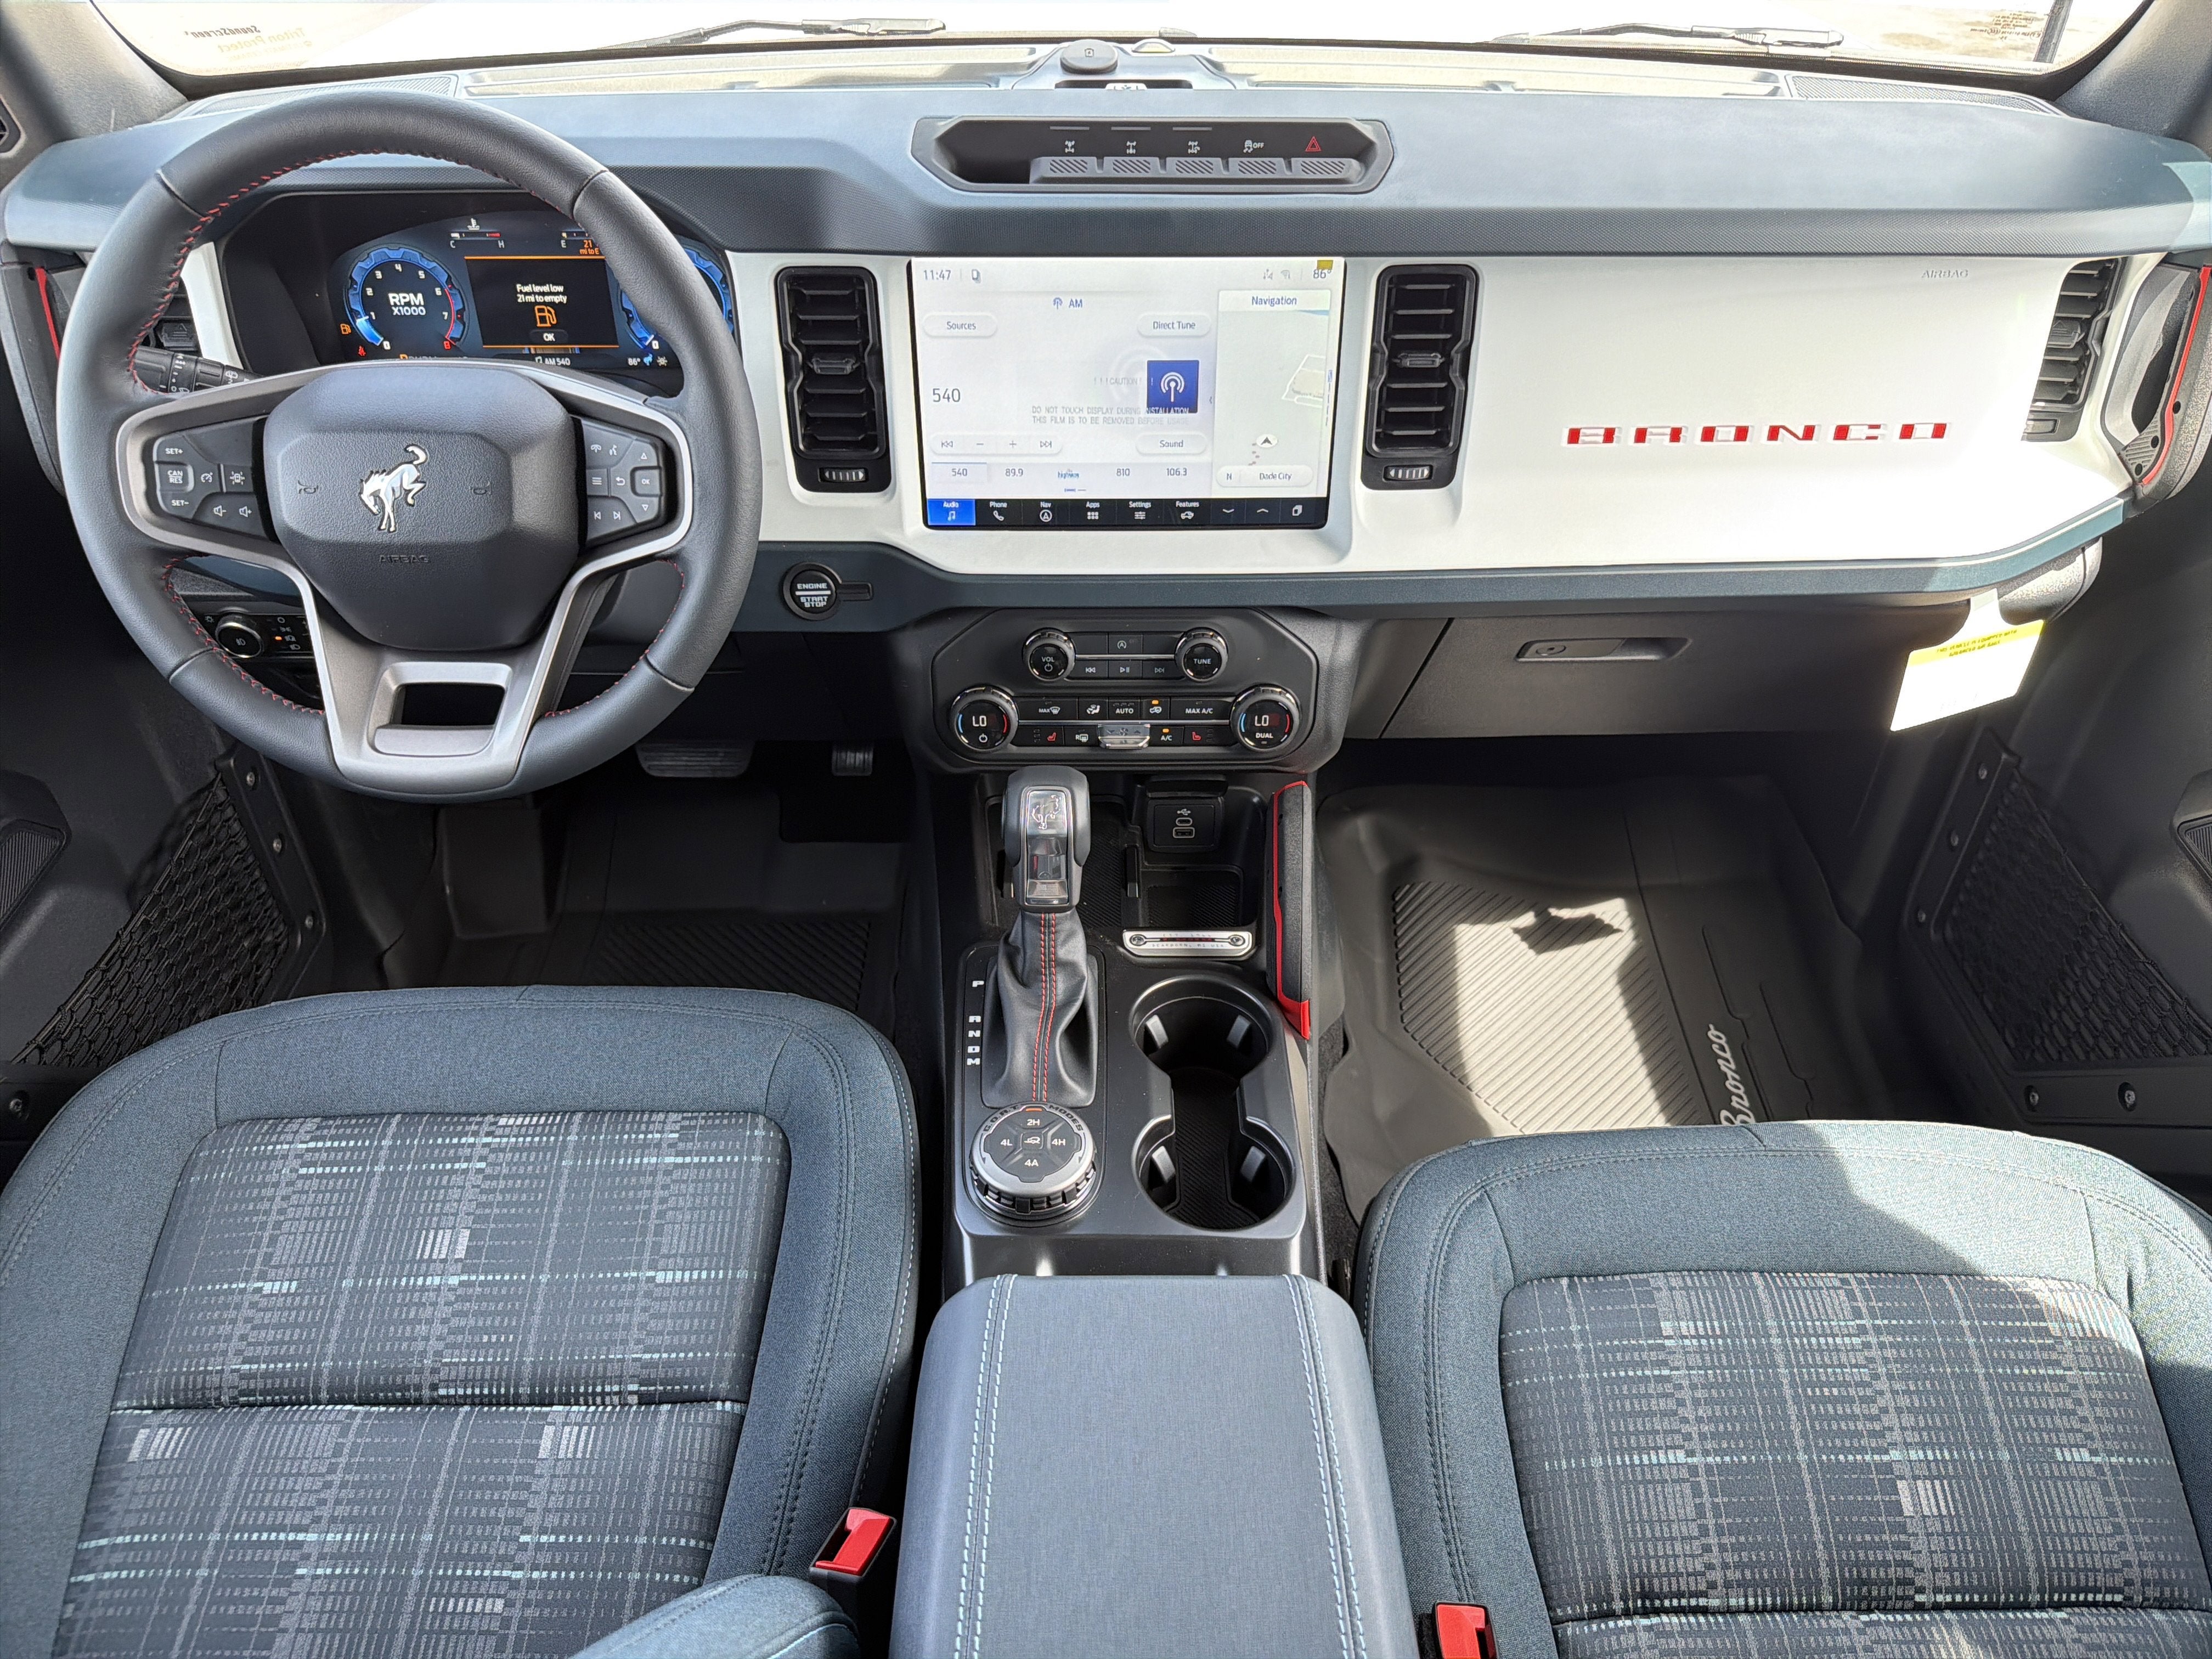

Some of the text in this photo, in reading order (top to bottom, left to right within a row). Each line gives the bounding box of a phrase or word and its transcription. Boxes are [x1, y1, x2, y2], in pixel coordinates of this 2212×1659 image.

[583, 240, 592, 248] 21
[394, 263, 402, 272] 4
[375, 270, 382, 279] 3
[418, 270, 425, 279] 5
[923, 269, 952, 281] 11:47
[1921, 268, 1968, 279] AIRBAG
[366, 287, 373, 296] 2
[435, 287, 442, 296] 6
[516, 283, 563, 292] Fuel level low
[388, 293, 424, 306] RPM
[517, 294, 525, 303] 21
[525, 294, 535, 302] mi
[544, 295, 567, 304] empty
[1068, 298, 1083, 308] AM
[1251, 295, 1297, 307] Navigation
[391, 306, 426, 316] X1000
[370, 312, 376, 320] 1
[442, 312, 448, 320] 7
[946, 321, 977, 330] Sources
[1153, 320, 1196, 330] Direct Tune
[543, 332, 555, 342] OK
[383, 341, 391, 350] 0
[545, 357, 571, 366] AM 540
[627, 357, 641, 366] 86°
[932, 388, 961, 403] 540
[1145, 407, 1189, 415] NSTALLATION
[1032, 416, 1047, 424] THIS
[1050, 416, 1065, 424] FILM
[1068, 416, 1075, 424] IS
[1091, 416, 1099, 425] BE
[1103, 416, 1135, 425] REMOVED
[1565, 422, 1948, 445] BRONCO
[1159, 440, 1184, 448] Sound
[951, 468, 968, 477] 540
[1005, 468, 1024, 477] 89.9
[1116, 468, 1130, 477] 810
[1166, 468, 1187, 476] 106.3
[1128, 501, 1152, 509] Settings
[967, 1046, 980, 1054] D
[1707, 1023, 1756, 1125] Bronco
[1048, 1104, 1084, 1131] MODES
[1051, 1138, 1066, 1147] 4H
[1024, 1159, 1039, 1167] 4A
